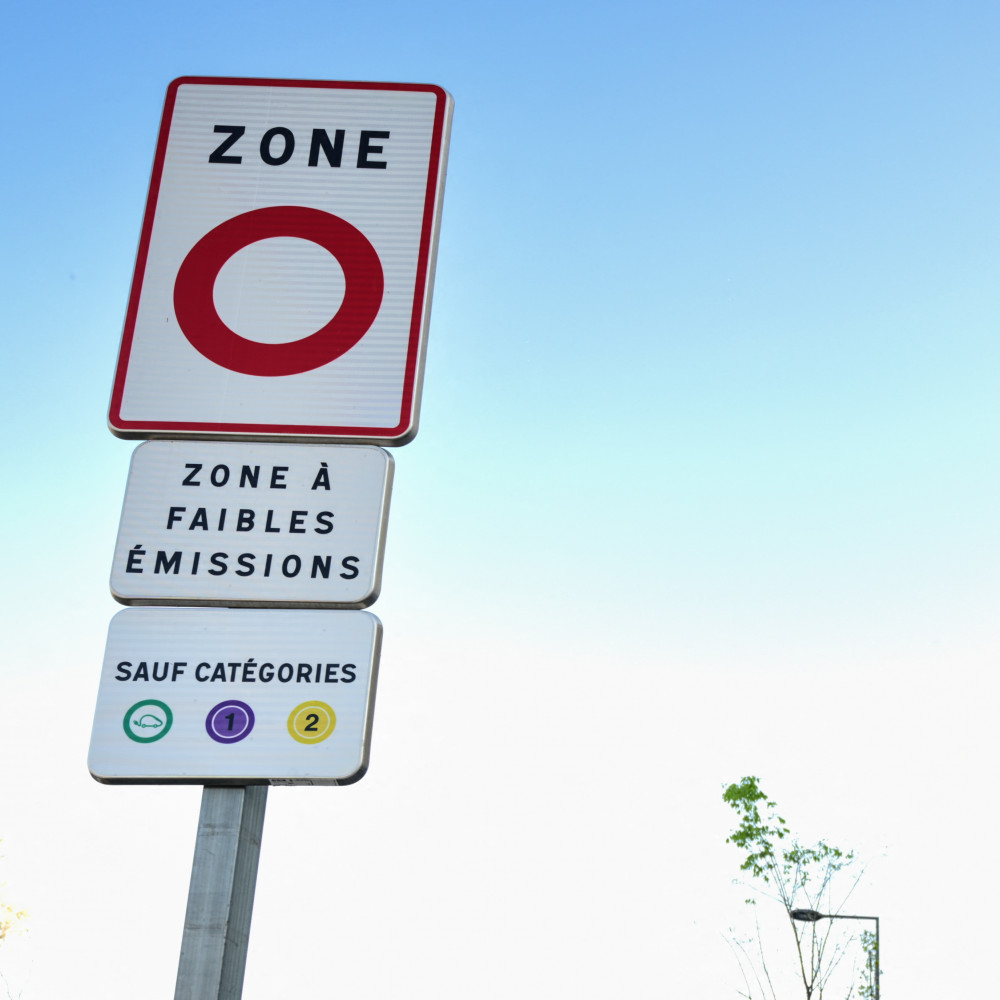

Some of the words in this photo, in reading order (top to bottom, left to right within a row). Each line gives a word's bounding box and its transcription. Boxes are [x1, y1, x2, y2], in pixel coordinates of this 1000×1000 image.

[208, 124, 391, 170] ZONE
[181, 463, 290, 490] ZONE
[311, 462, 332, 491] À
[166, 506, 335, 535] FAIBLES
[125, 544, 361, 580] ÉMISSIONS
[114, 660, 188, 684] SAUF
[194, 657, 358, 684] CATÉGORIES
[224, 711, 236, 731] 1
[304, 713, 320, 732] 2
